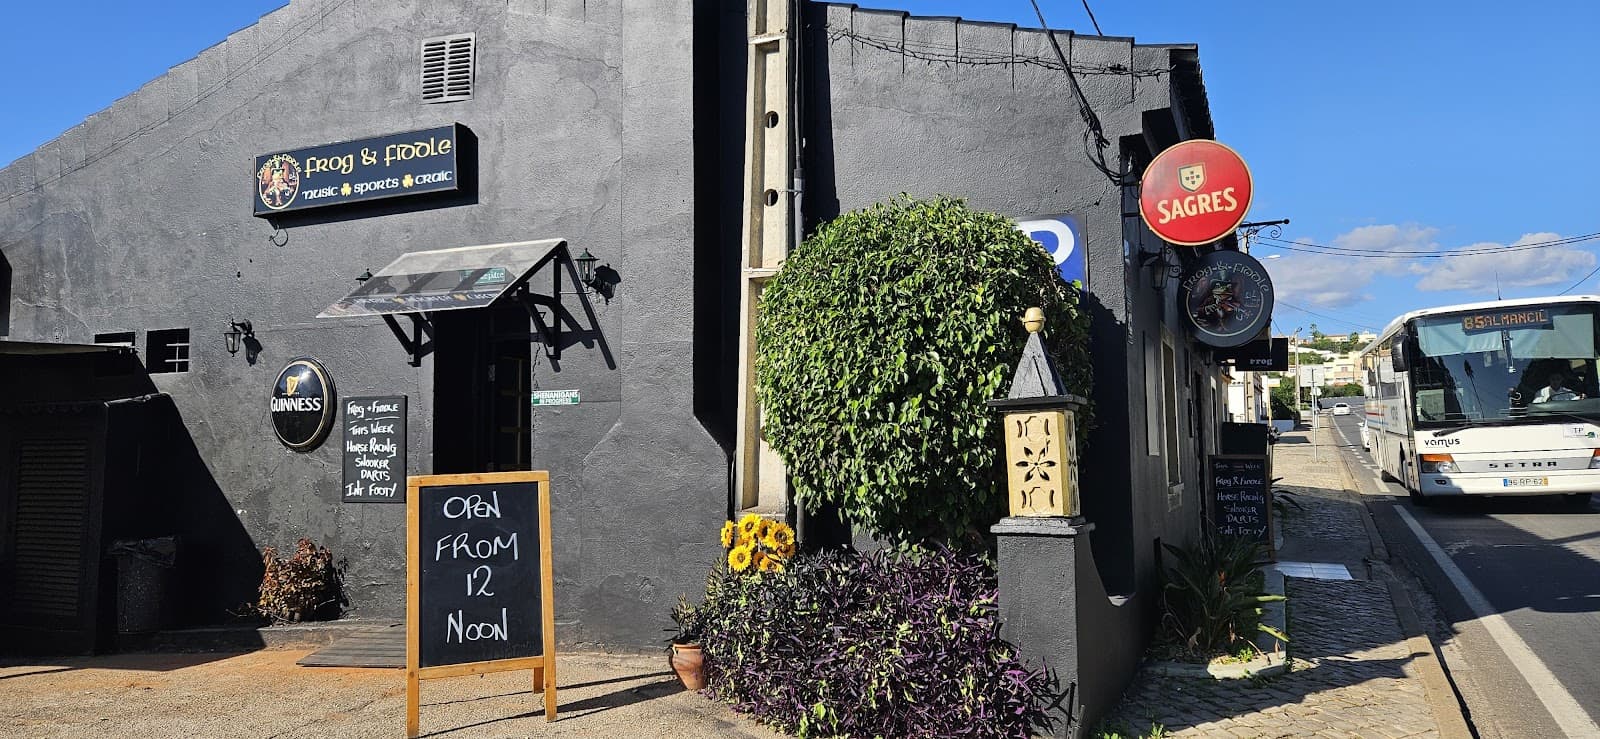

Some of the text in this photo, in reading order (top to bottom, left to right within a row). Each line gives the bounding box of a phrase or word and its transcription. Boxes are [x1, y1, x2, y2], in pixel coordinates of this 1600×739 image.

[360, 147, 377, 166] &
[1157, 186, 1238, 225] SAGRES
[270, 396, 321, 412] GUINNESS
[370, 421, 394, 434] WEEK
[346, 440, 368, 455] HORSE
[1423, 438, 1461, 448] vamus
[1488, 461, 1558, 469] SETRA
[360, 469, 391, 482] DARTS
[368, 482, 397, 497] FOOTY
[443, 491, 502, 519] OPEN
[435, 532, 519, 561] FROM
[466, 564, 494, 597] 12
[446, 607, 508, 644] NOON
